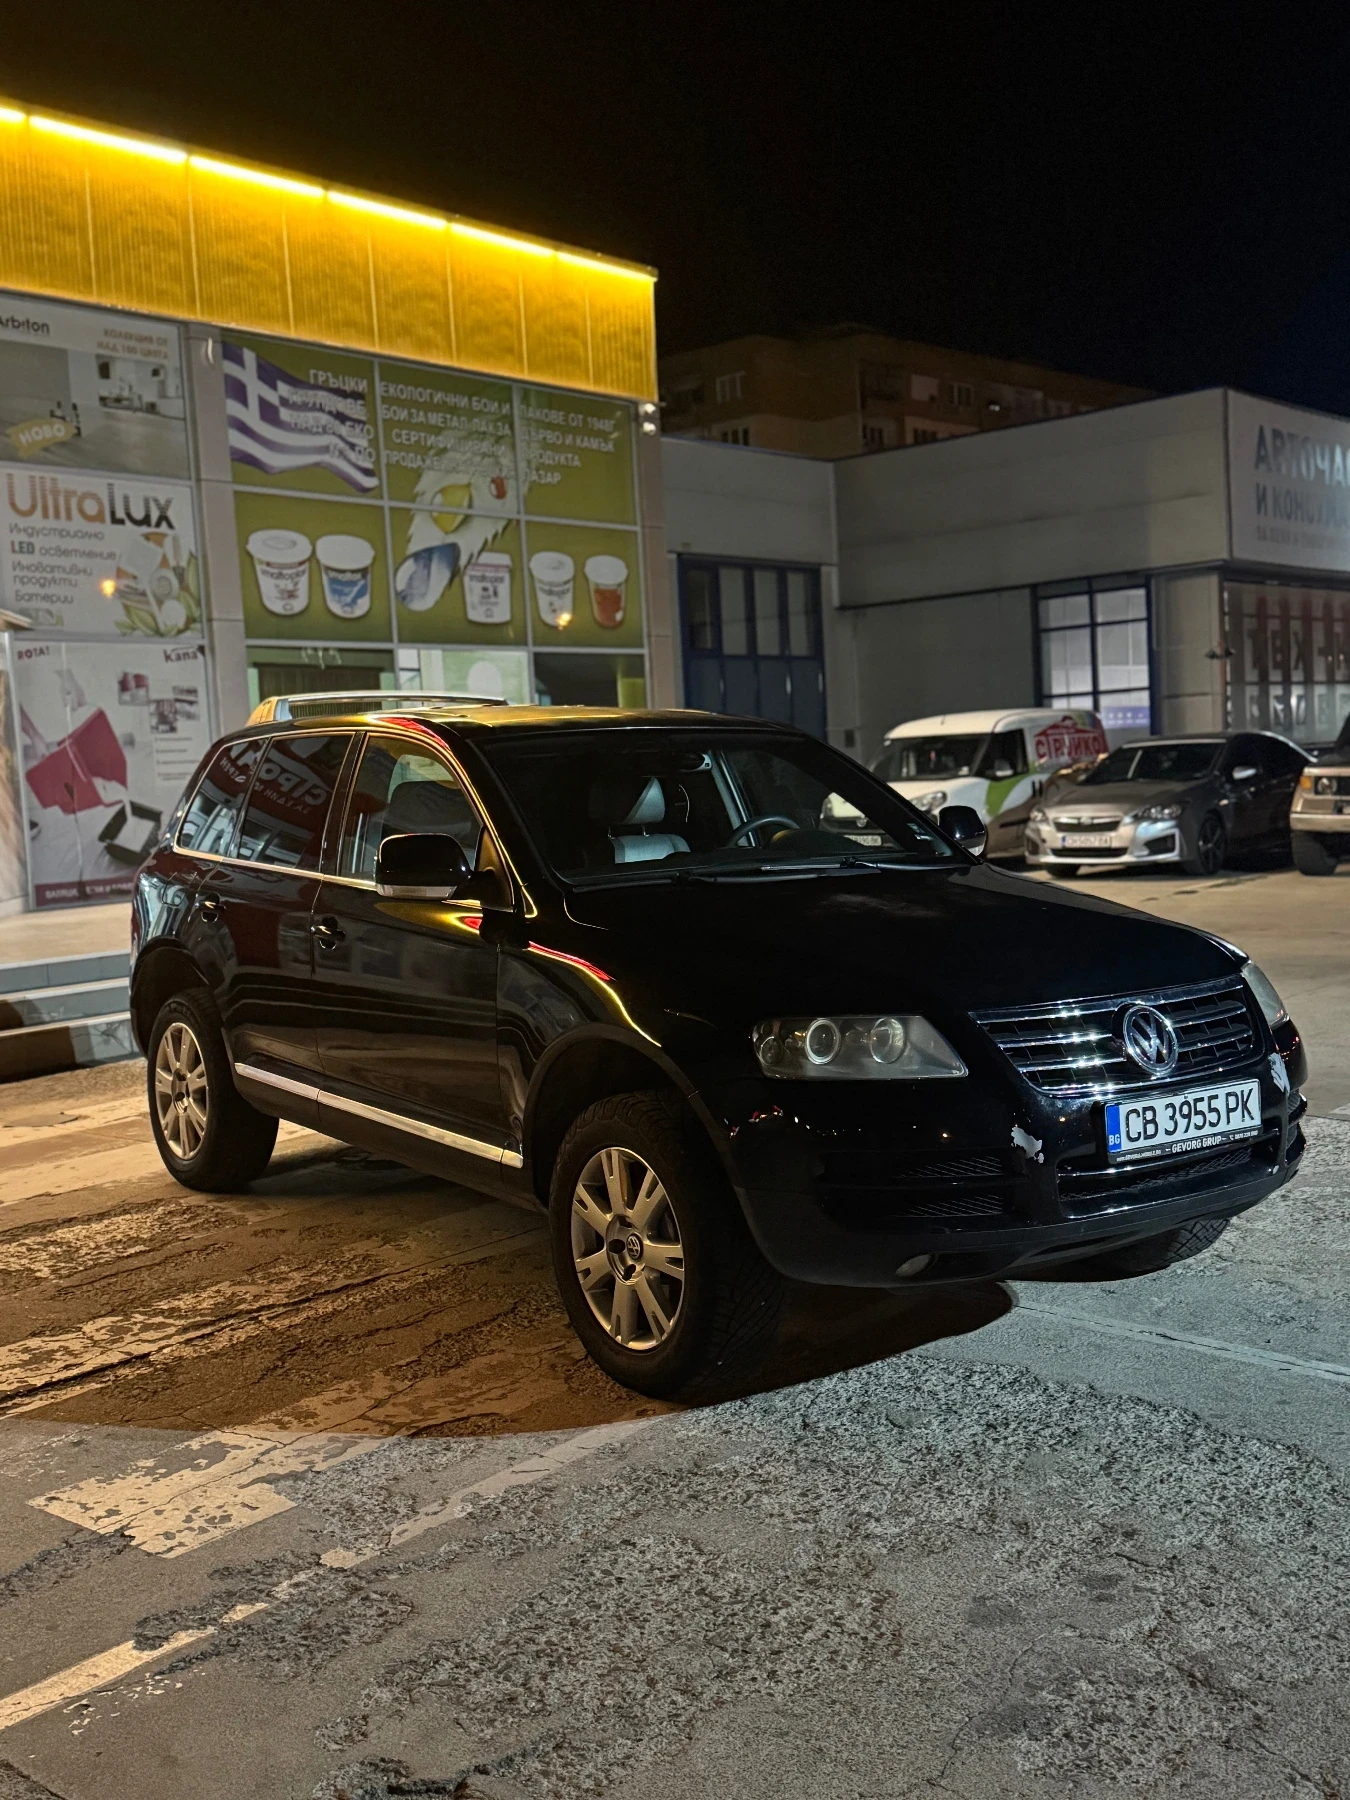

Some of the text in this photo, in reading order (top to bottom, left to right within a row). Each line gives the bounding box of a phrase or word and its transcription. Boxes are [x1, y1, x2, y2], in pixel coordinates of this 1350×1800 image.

[309, 369, 368, 394] ГРЪЦКИ
[380, 381, 470, 409] ЕКОЛОГИЧНИ
[471, 396, 499, 414] БОИ
[567, 412, 583, 427] ОТ
[381, 404, 409, 421] БОИ
[410, 409, 427, 425] ЗА
[19, 423, 65, 446] НОВО
[9, 522, 105, 541] Индустриално
[10, 539, 118, 561] LED осветление
[12, 560, 94, 577] Иновативни
[13, 574, 79, 589] продукти
[14, 589, 75, 605] Батерии
[1125, 1087, 1255, 1143] CB 3955 PK
[1108, 1134, 1120, 1146] BG
[1171, 1140, 1202, 1154] GEVORG
[1202, 1135, 1222, 1148] GRUP
